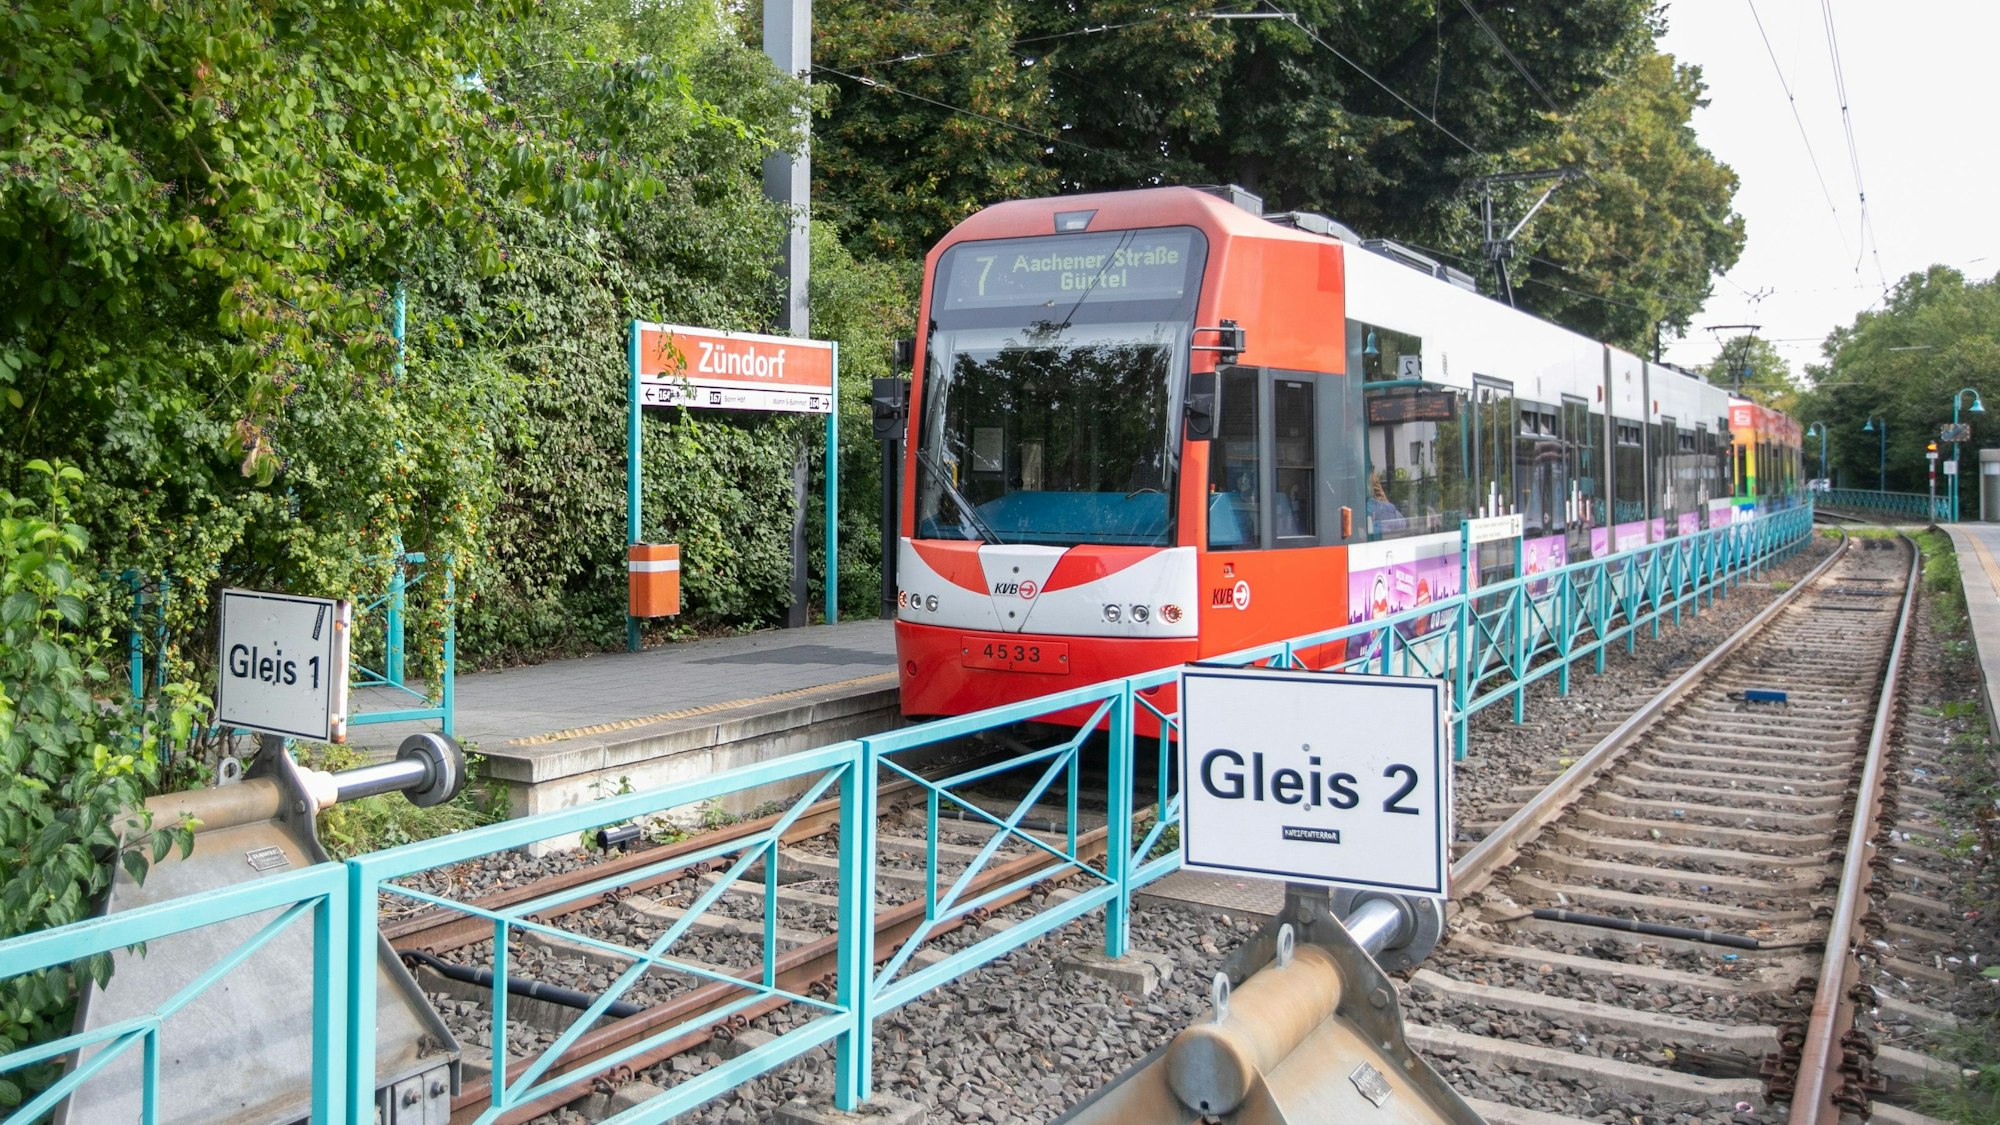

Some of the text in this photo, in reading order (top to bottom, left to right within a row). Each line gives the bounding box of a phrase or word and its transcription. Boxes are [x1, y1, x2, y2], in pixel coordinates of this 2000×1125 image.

[1012, 246, 1179, 273] Aachener Straße
[977, 256, 994, 296] 7
[1060, 268, 1127, 291] Gürtel
[698, 341, 786, 379] Zündorf
[710, 391, 721, 404] 167
[994, 582, 1019, 595] KVB
[1212, 587, 1233, 605] KVB
[984, 643, 1040, 663] 4533
[229, 643, 320, 689] Gleis 1
[1200, 748, 1419, 815] Gleis 2
